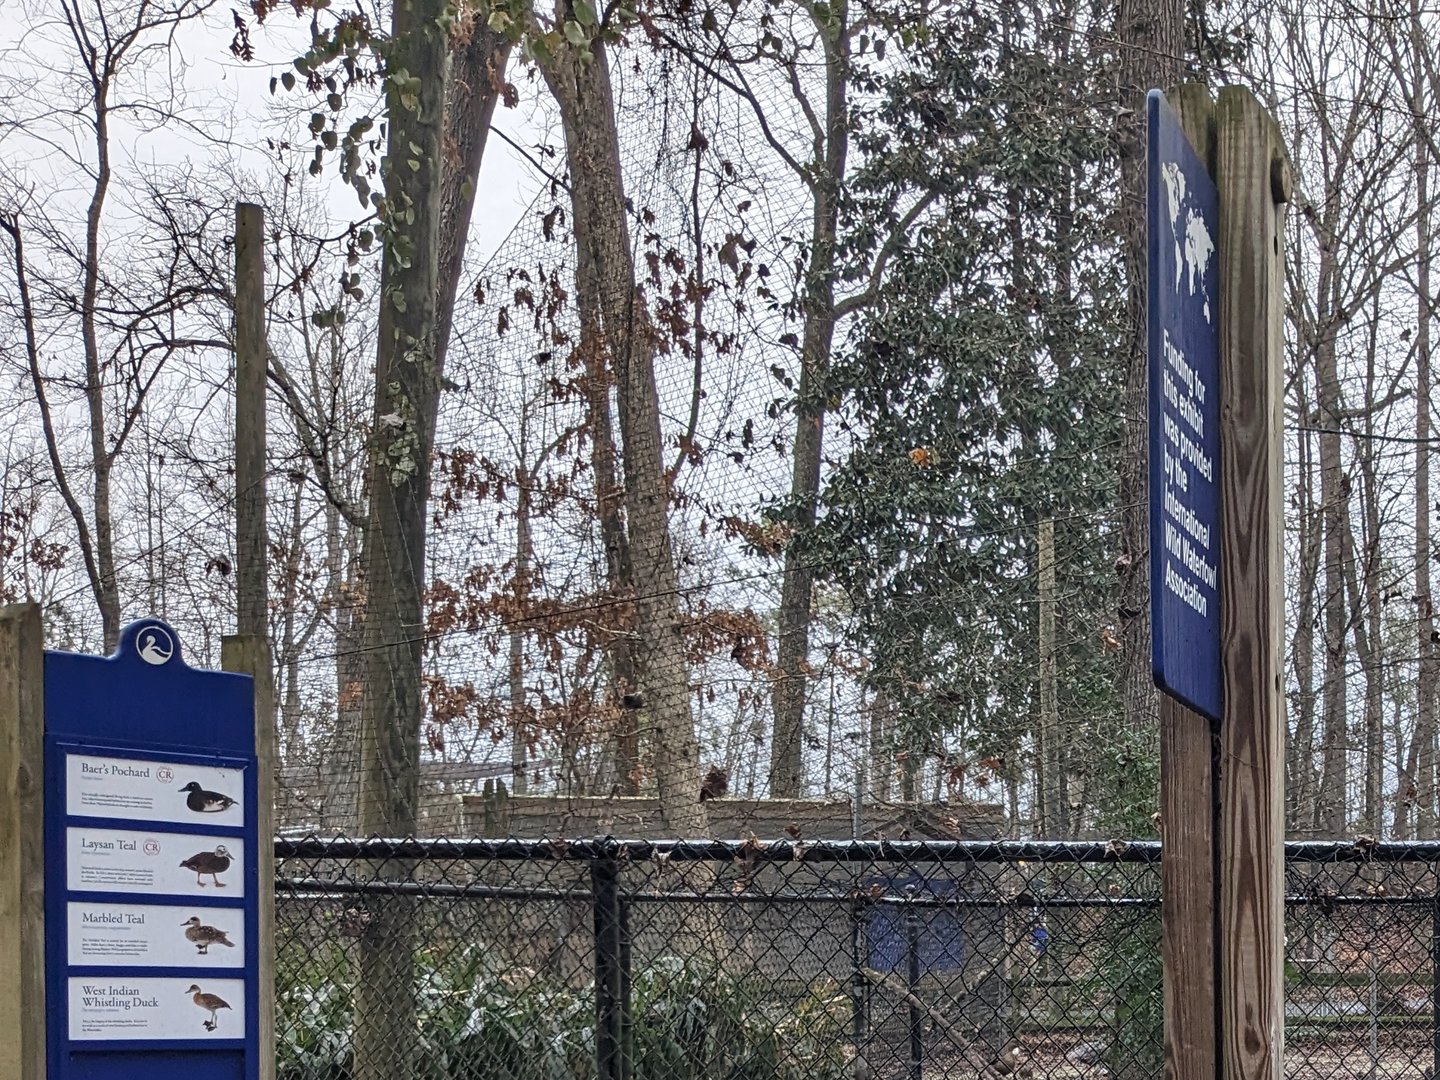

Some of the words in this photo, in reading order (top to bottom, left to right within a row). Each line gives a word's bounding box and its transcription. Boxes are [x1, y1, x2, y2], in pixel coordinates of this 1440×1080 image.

[1163, 328, 1194, 398] Funding
[1194, 370, 1205, 404] for
[1163, 369, 1178, 408] this
[1179, 393, 1204, 438] exhibit
[1163, 411, 1179, 447] was
[1180, 431, 1212, 483] provided
[1164, 443, 1174, 485] by
[1175, 457, 1187, 492] the
[1164, 482, 1210, 549] International
[1165, 519, 1181, 560] Wild
[1182, 535, 1216, 590] Waterfowl
[1165, 559, 1207, 618] Association
[81, 763, 109, 775] Baer's
[111, 765, 150, 778] Pochard
[82, 838, 114, 852] Laysan
[116, 840, 137, 851] Teal
[82, 912, 123, 924] Marbled
[125, 913, 145, 924] Teal
[82, 985, 106, 996] West
[109, 985, 139, 996] Indian
[82, 997, 131, 1009] Whistling
[133, 997, 159, 1008] Duck
